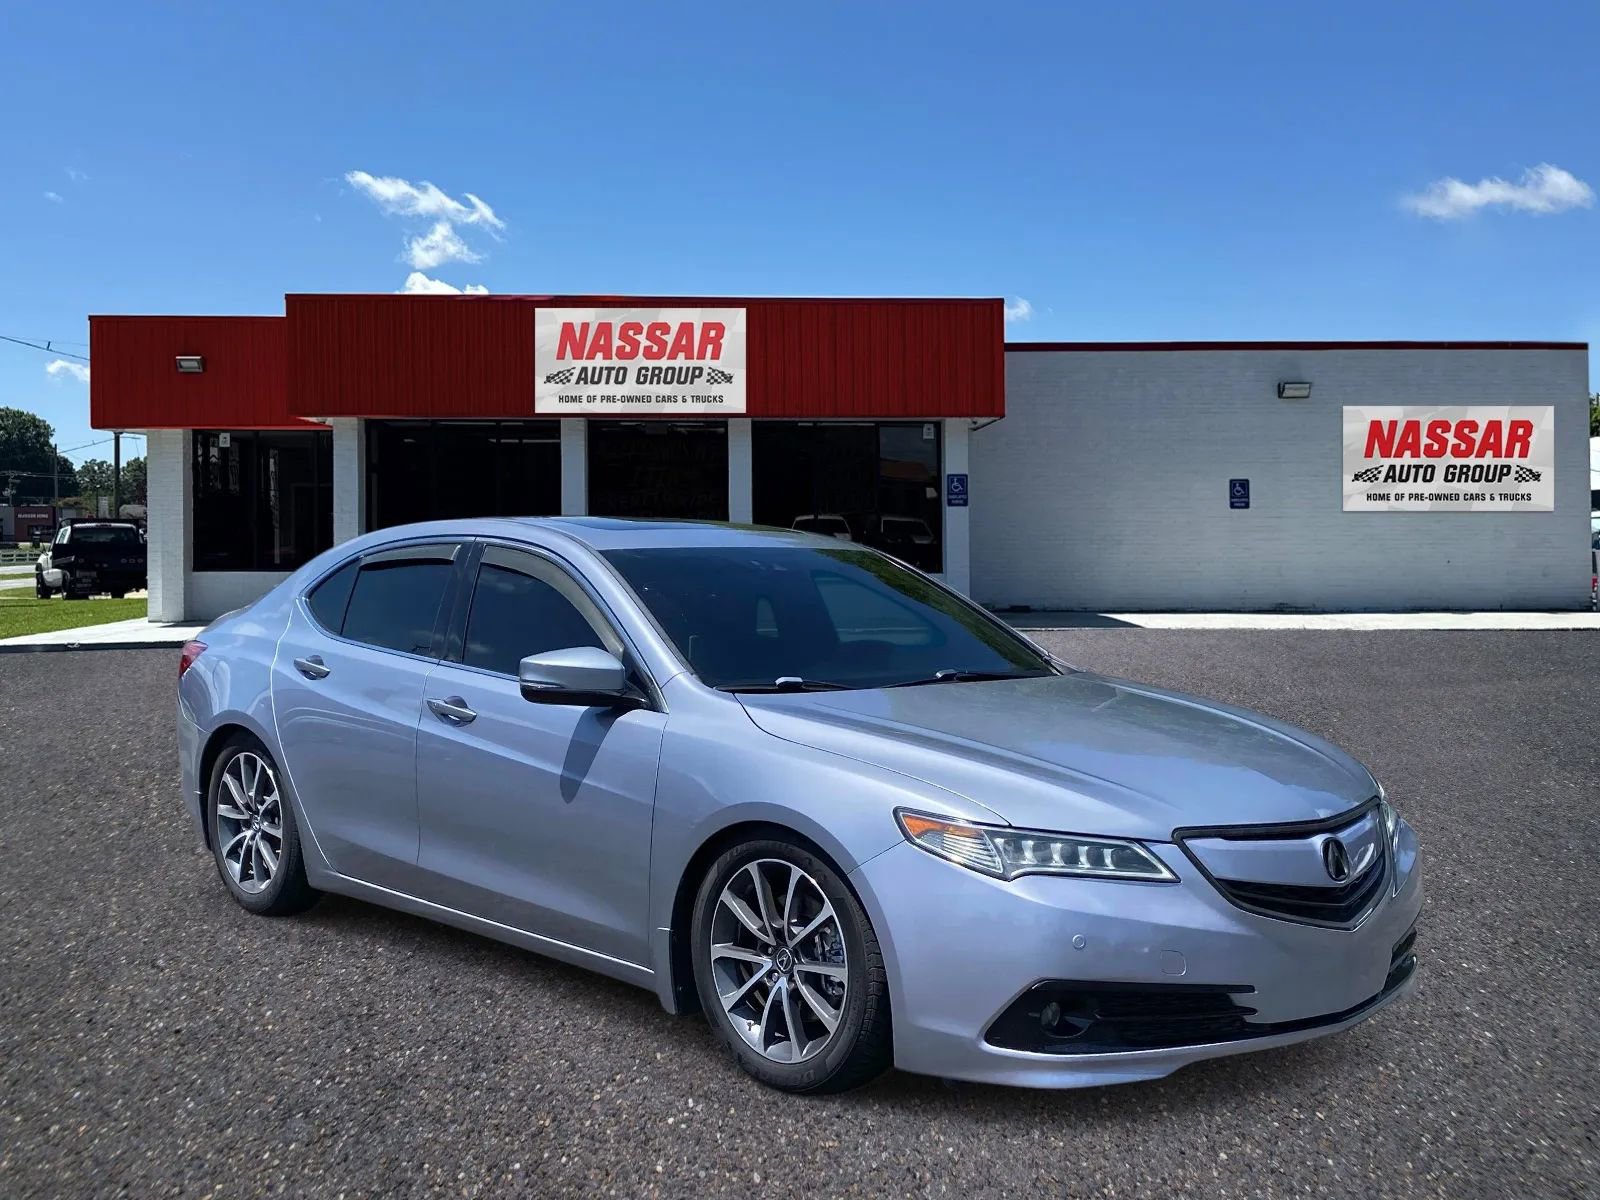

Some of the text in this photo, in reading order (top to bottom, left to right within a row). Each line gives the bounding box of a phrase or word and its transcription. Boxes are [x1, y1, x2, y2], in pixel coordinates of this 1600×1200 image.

[555, 321, 726, 361] NASSAR
[574, 366, 704, 386] AUTO GROUP
[558, 394, 724, 404] HOME OF PRE-OWNED CARS & TRUCKS
[1363, 419, 1534, 459] NASSAR
[1382, 464, 1512, 484] AUTO GROUP
[1366, 492, 1532, 502] HOME OF PRE-OWNED CARS & TRUCKS
